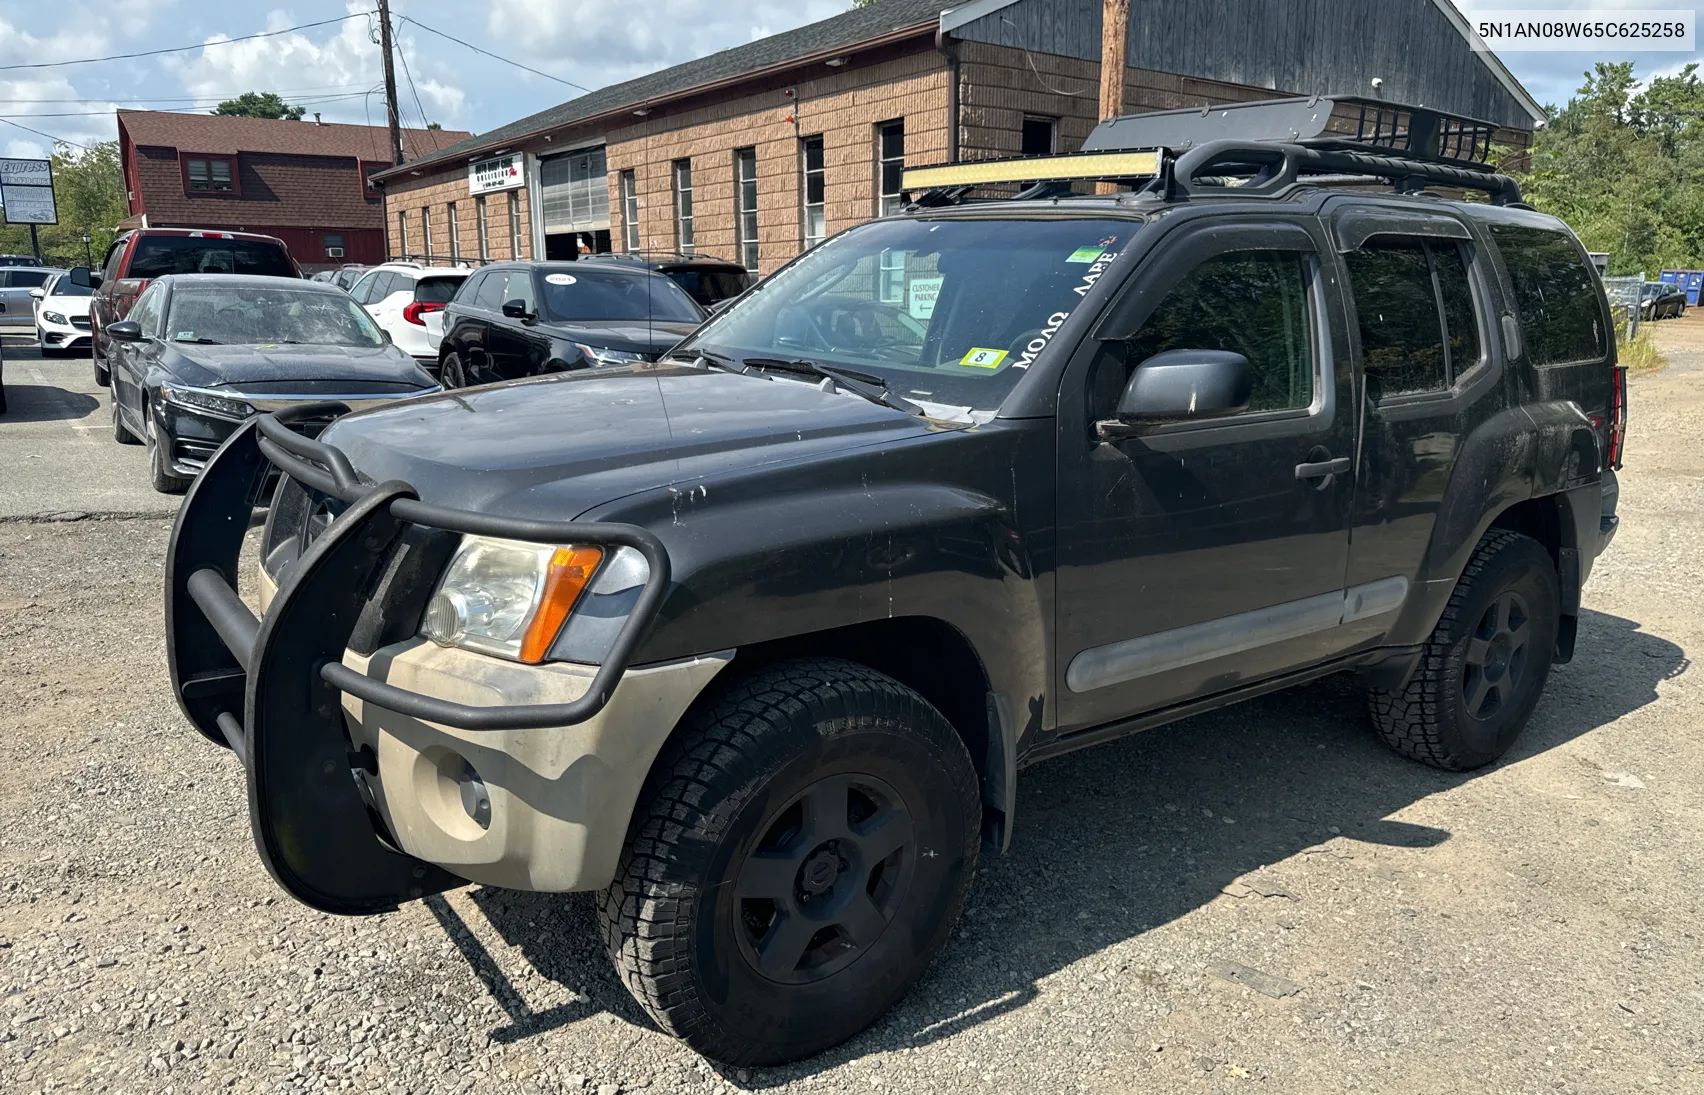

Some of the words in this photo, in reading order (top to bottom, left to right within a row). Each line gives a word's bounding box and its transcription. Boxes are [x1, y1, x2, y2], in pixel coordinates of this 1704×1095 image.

[1, 161, 48, 174] Express
[912, 283, 940, 292] CUSTOMER
[915, 293, 937, 301] PARKING
[975, 352, 987, 362] 8
